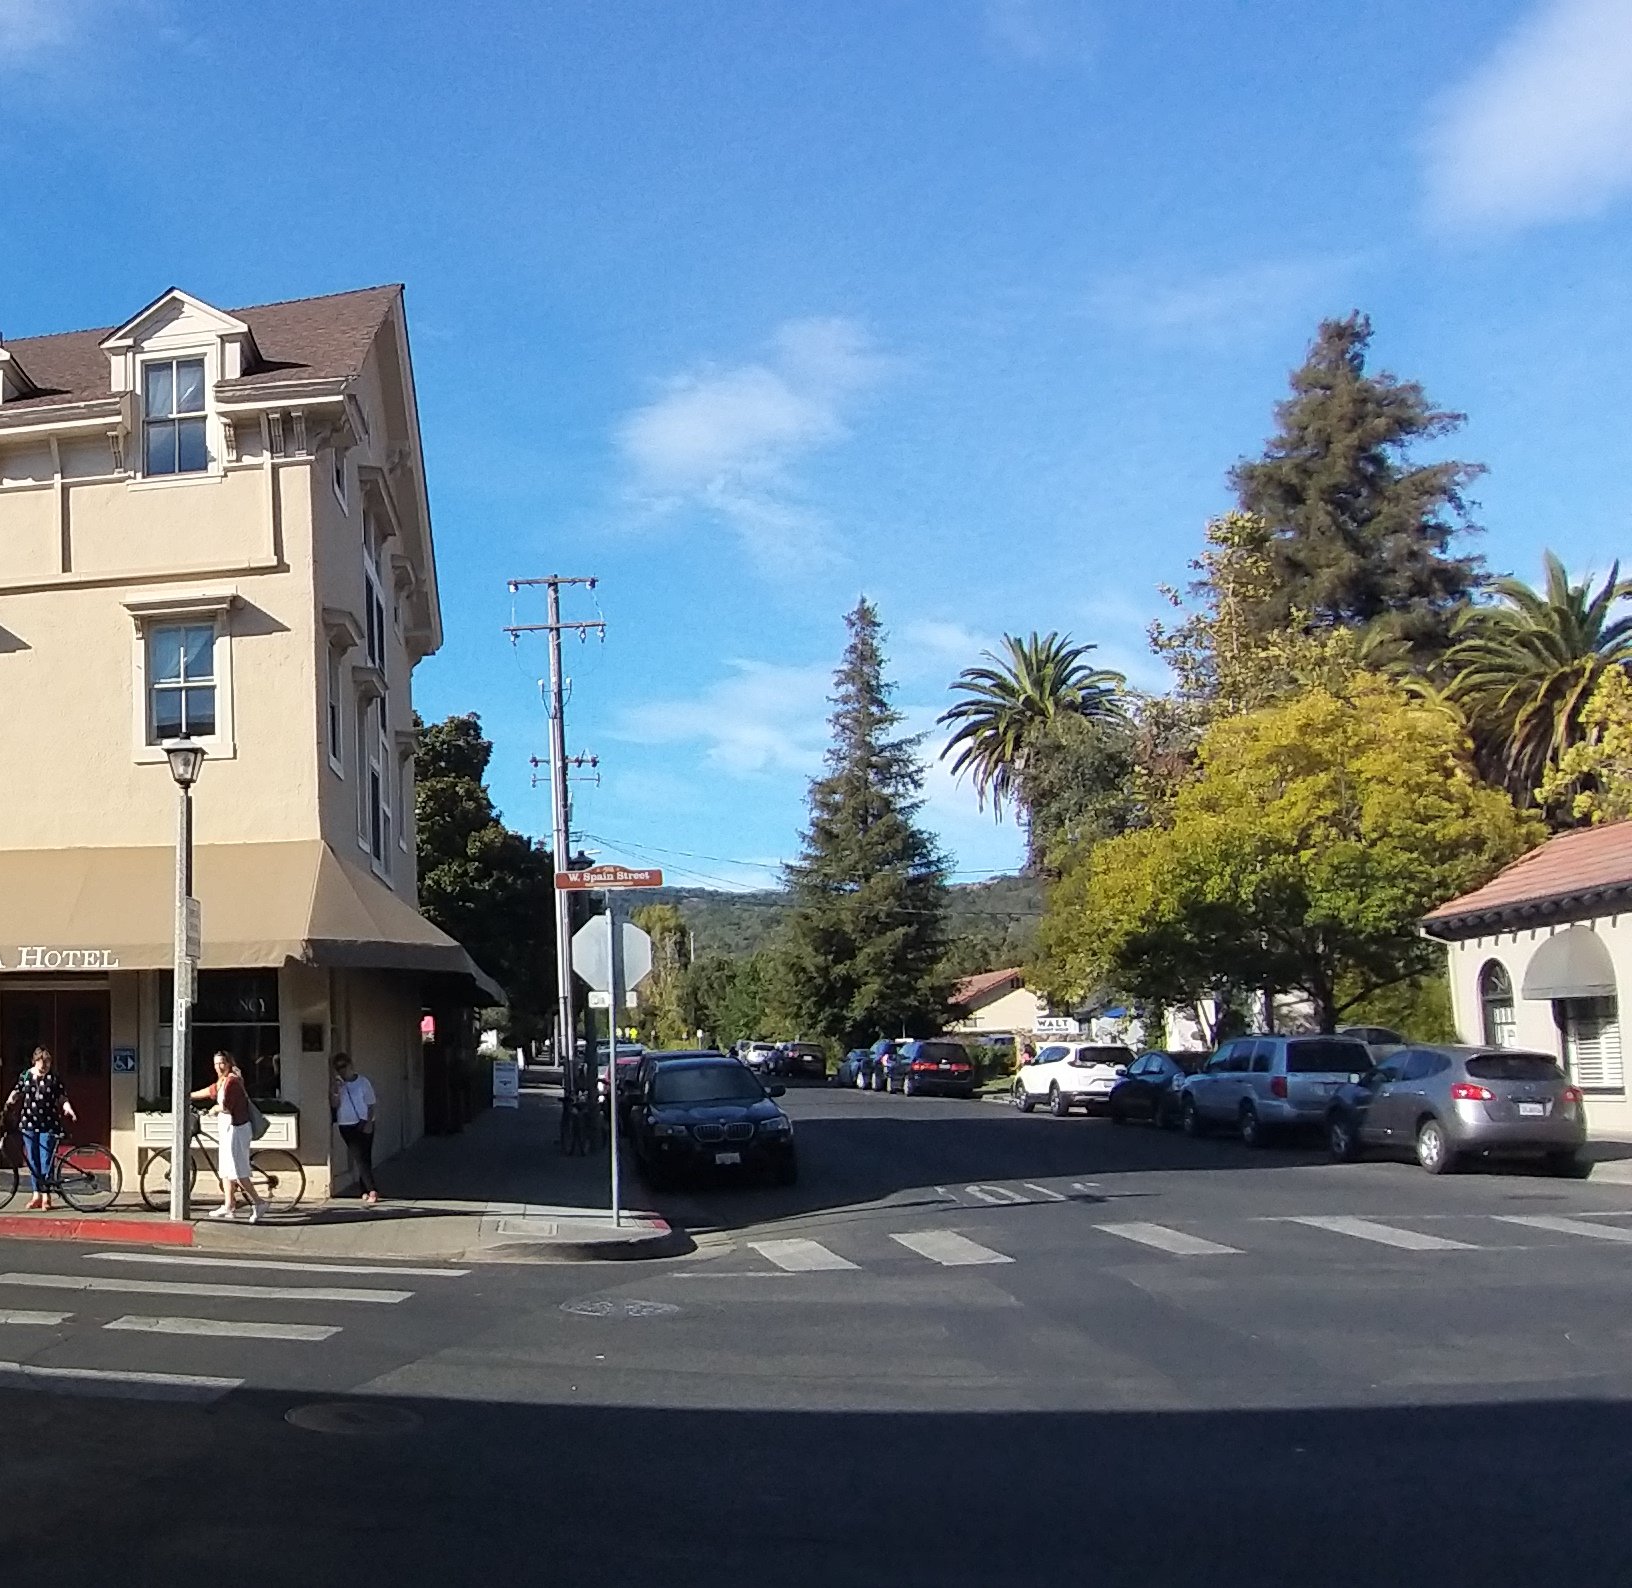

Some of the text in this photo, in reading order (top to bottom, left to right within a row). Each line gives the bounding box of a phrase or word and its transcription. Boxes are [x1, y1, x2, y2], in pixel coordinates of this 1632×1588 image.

[568, 871, 650, 883] W. Spain Street
[17, 946, 119, 968] HOTEL
[1037, 1019, 1068, 1027] WALT
